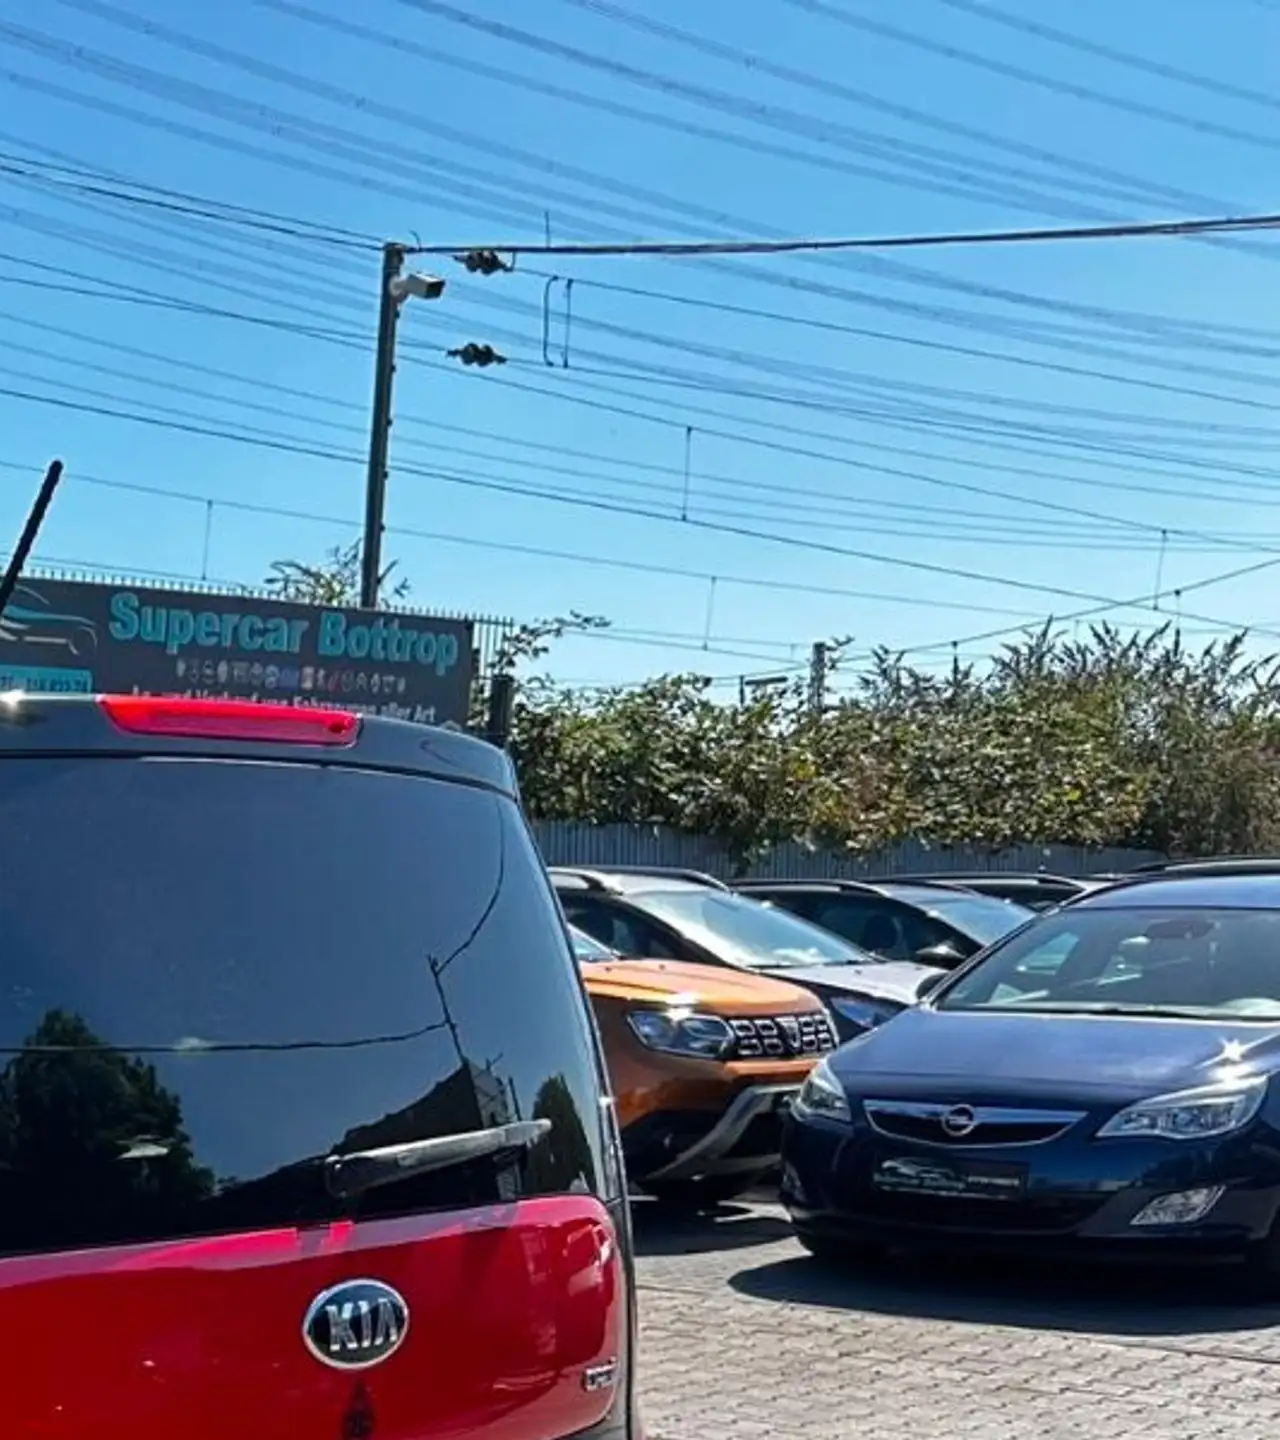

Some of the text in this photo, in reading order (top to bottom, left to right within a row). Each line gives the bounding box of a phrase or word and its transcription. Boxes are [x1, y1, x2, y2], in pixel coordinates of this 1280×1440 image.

[110, 592, 458, 675] Supercar Bottrop
[325, 1298, 398, 1352] KIA
